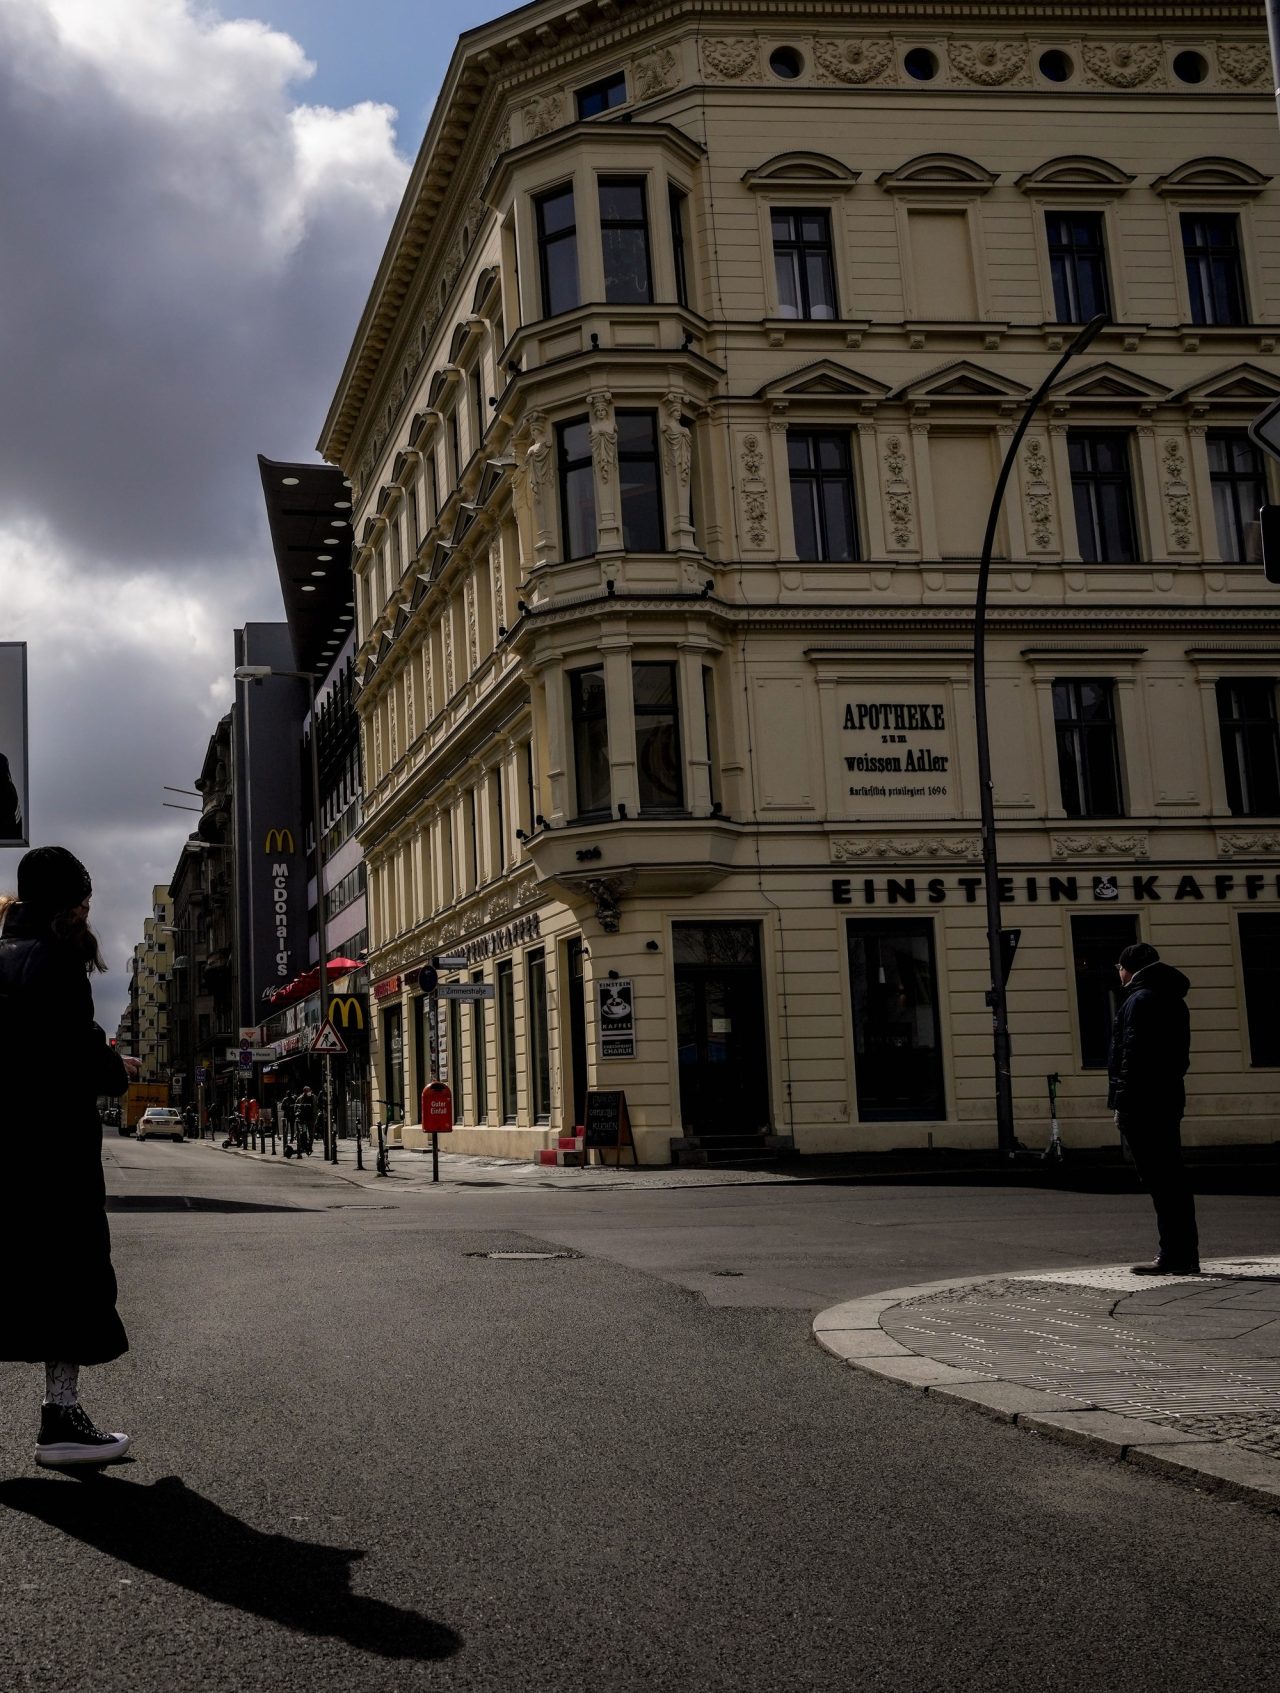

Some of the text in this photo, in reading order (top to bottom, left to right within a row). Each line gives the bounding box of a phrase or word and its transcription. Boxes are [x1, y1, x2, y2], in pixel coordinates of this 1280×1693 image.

[843, 703, 945, 730] APOTHEKE
[881, 735, 907, 743] zum
[845, 748, 948, 773] weissen Adler
[928, 786, 947, 796] 1696
[832, 874, 1280, 904] EINSTEIN KAFF
[271, 863, 293, 977] McDonald's
[446, 987, 487, 996] Zimmerstraße
